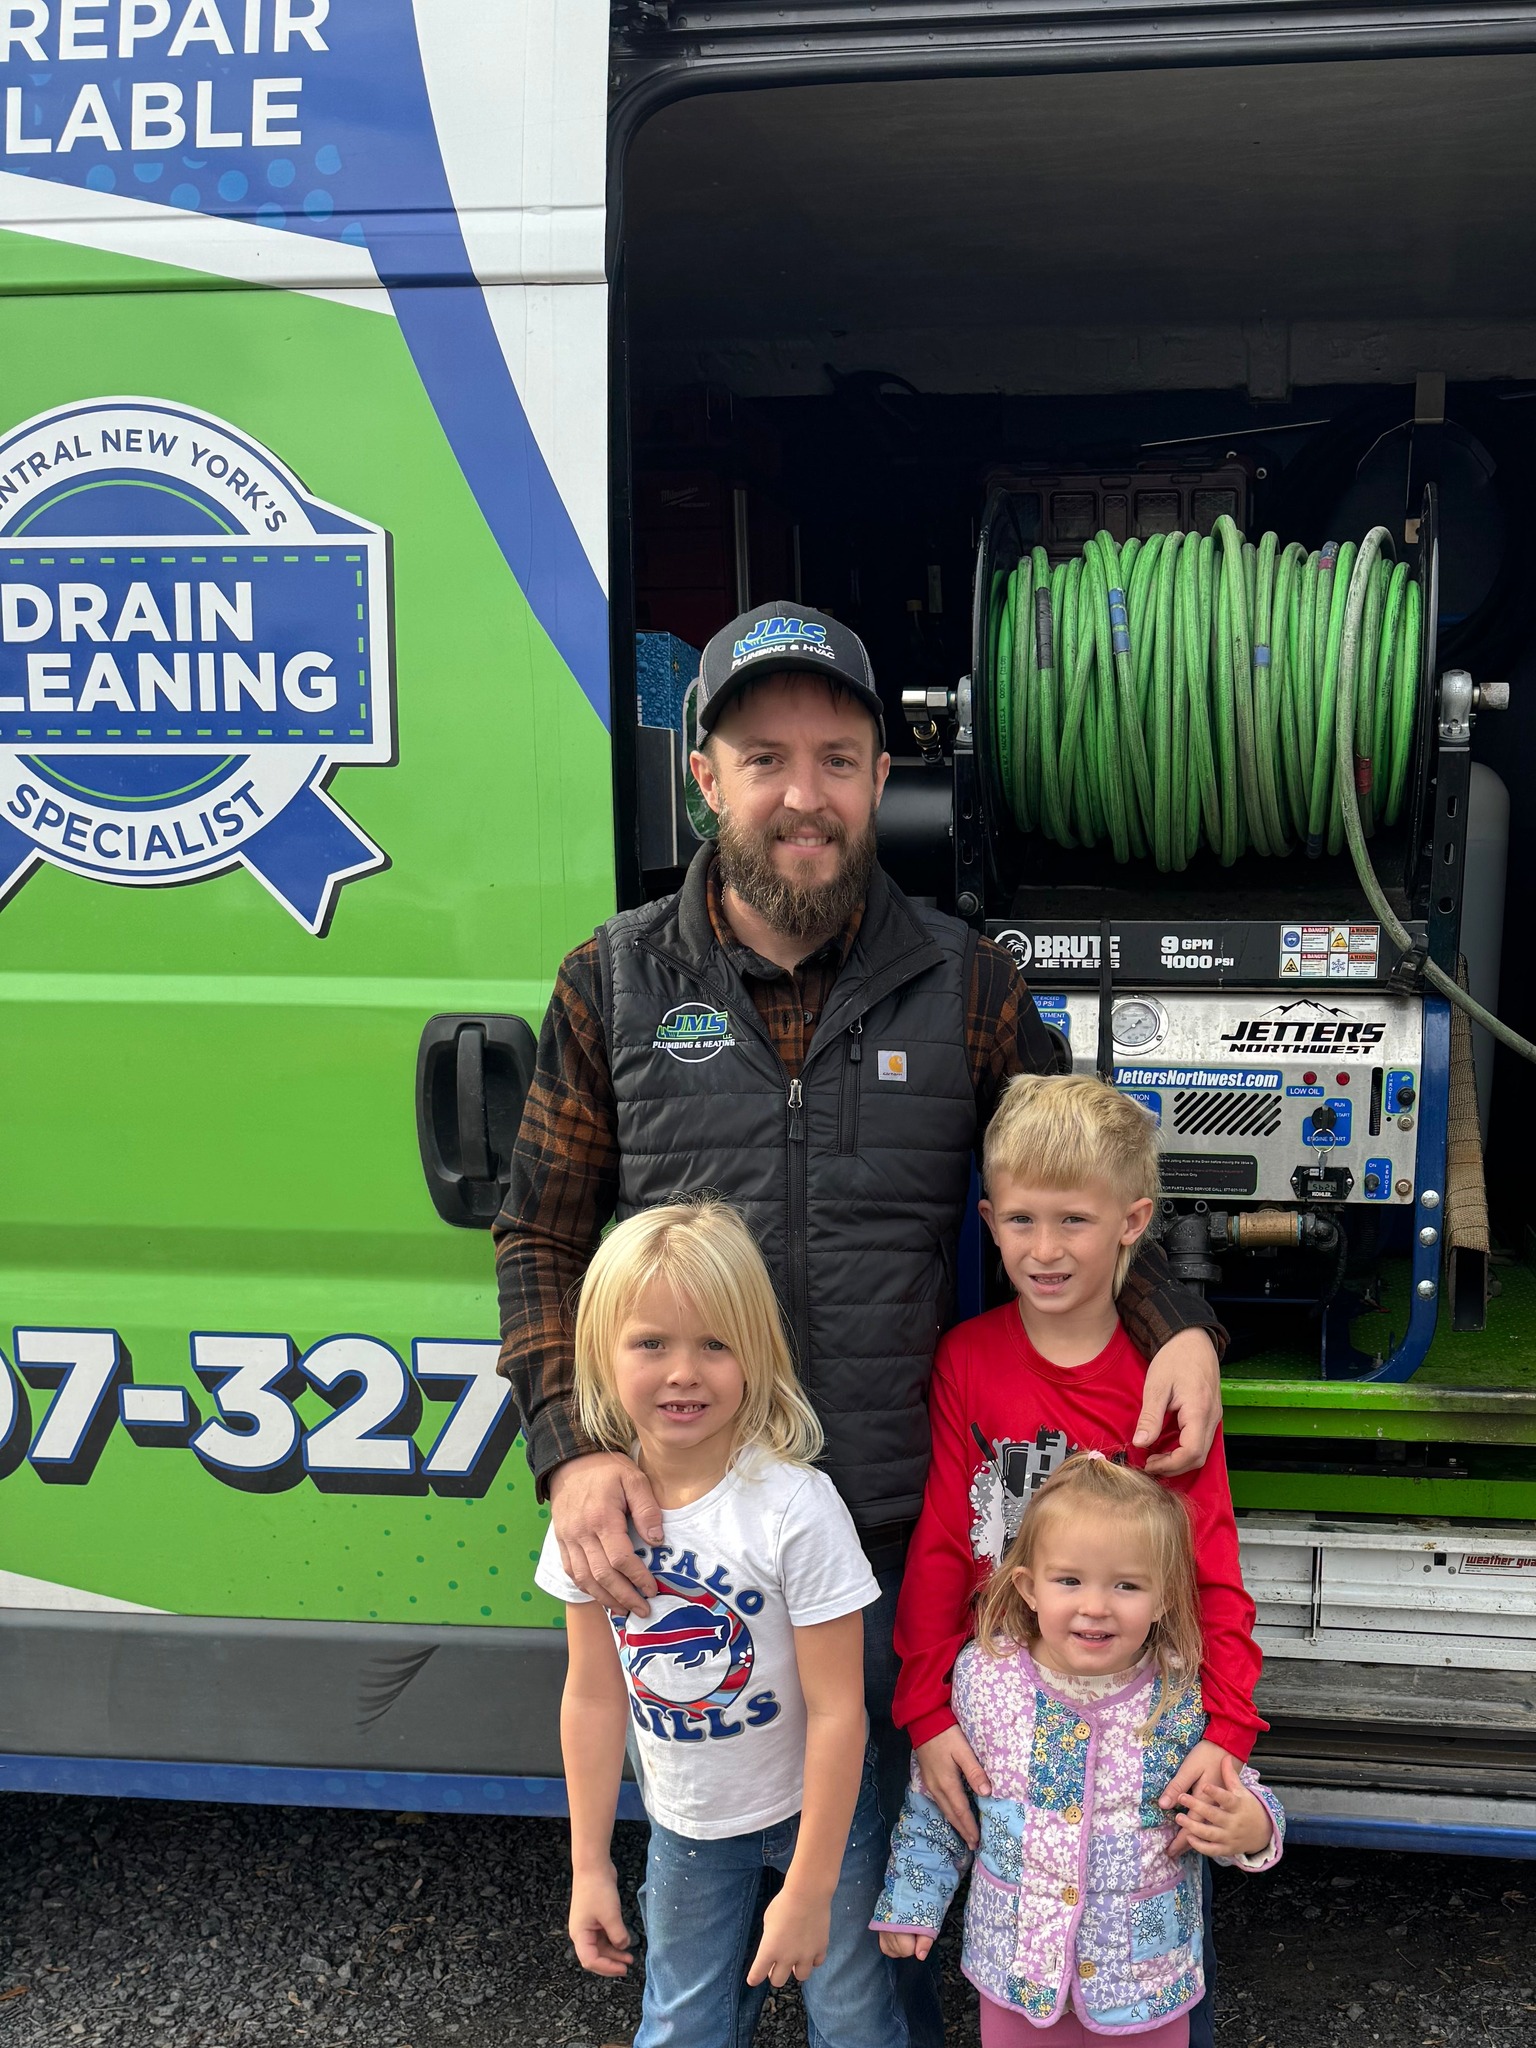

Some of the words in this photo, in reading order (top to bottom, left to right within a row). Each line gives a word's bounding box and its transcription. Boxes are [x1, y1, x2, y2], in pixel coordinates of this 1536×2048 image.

[0, 0, 330, 62] REPAIR
[5, 77, 303, 154] LABLE
[0, 435, 92, 511] NTRAL
[101, 429, 178, 457] NEW
[190, 442, 288, 533] YORK'S
[2, 582, 254, 643] DRAIN
[745, 617, 827, 644] JMS
[731, 645, 786, 671] PLUMBING
[803, 643, 836, 660] HVAC
[9, 780, 265, 863] SPECIALIST
[1034, 935, 1120, 958] BRUTE
[1160, 936, 1179, 954] 9
[1181, 938, 1213, 950] GPM
[1160, 955, 1213, 969] 4000
[1214, 957, 1235, 966] PSI
[667, 1011, 729, 1036] JMS
[1220, 1021, 1387, 1043] JETTERS
[652, 1040, 694, 1049] PLUMBING
[694, 1041, 702, 1049] &
[702, 1038, 736, 1048] HEATING
[1228, 1043, 1376, 1055] NORTHWEST
[1115, 1068, 1279, 1088] JettersNorthwest.com
[1289, 1087, 1307, 1095] LOW
[1307, 1087, 1321, 1096] OIL
[0, 1326, 517, 1478] 7-327
[1465, 1555, 1515, 1566] weather
[634, 1545, 765, 1616] FALO
